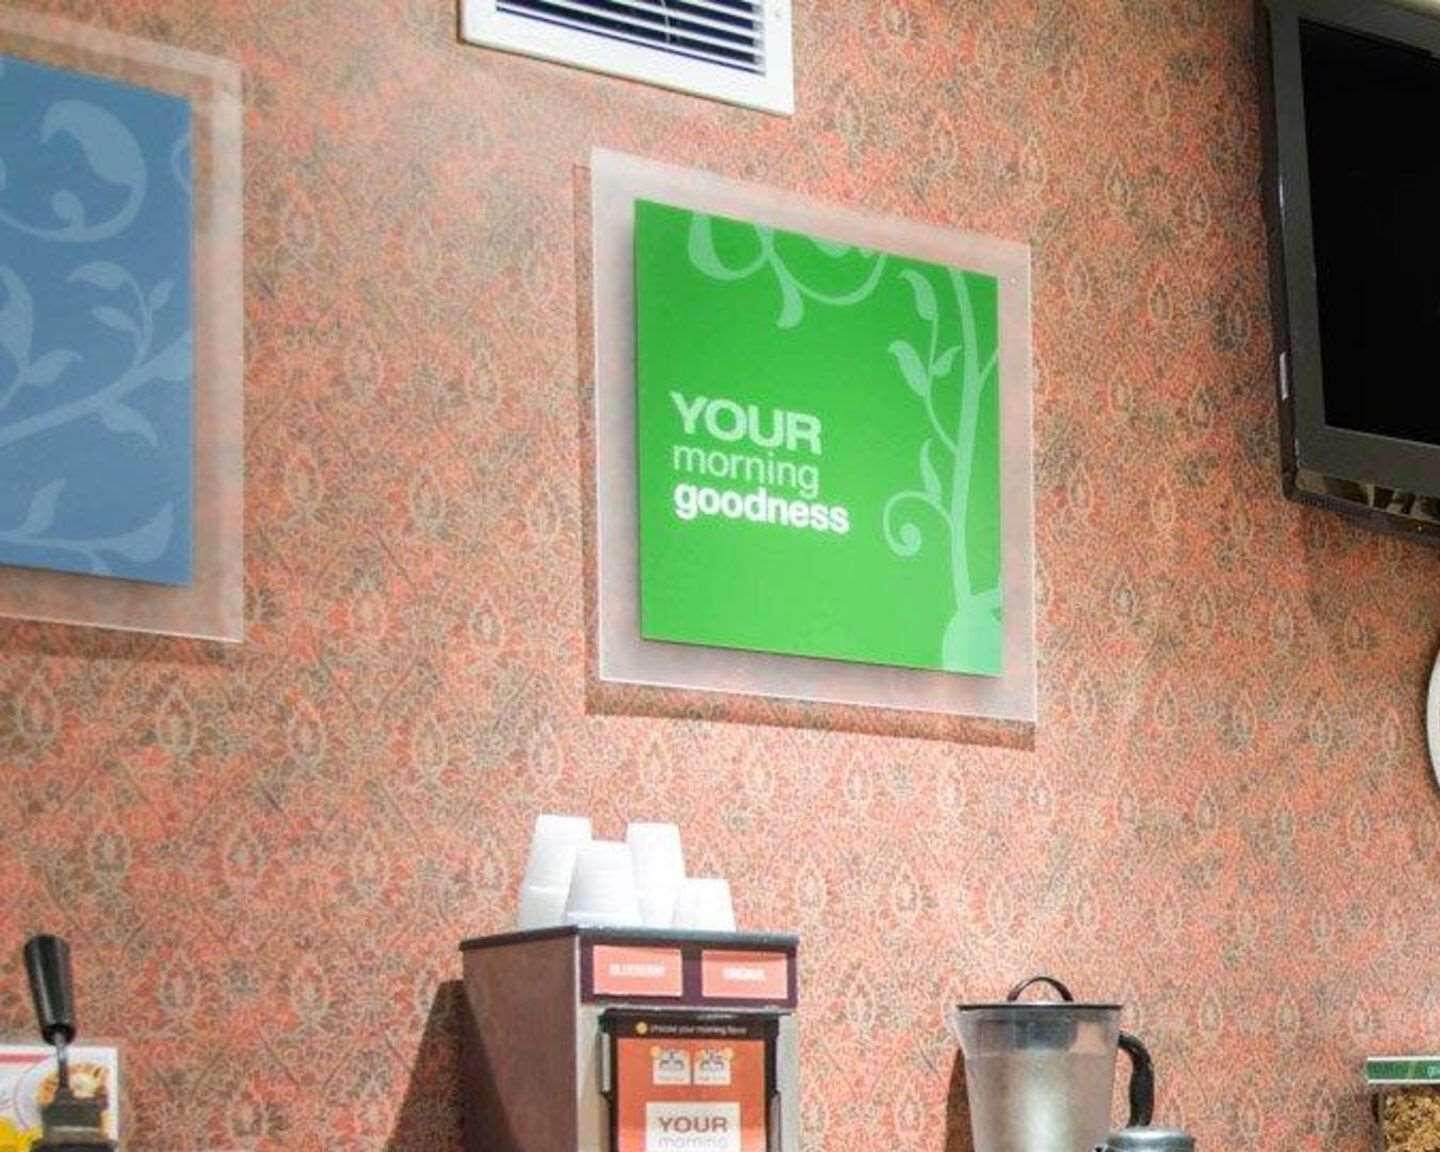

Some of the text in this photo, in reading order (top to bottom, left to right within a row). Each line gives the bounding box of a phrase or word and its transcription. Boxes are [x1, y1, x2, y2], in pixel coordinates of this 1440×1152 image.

[669, 391, 822, 455] YOUR
[673, 445, 819, 499] morning
[673, 483, 850, 534] goodness
[658, 1115, 728, 1134] YOUR
